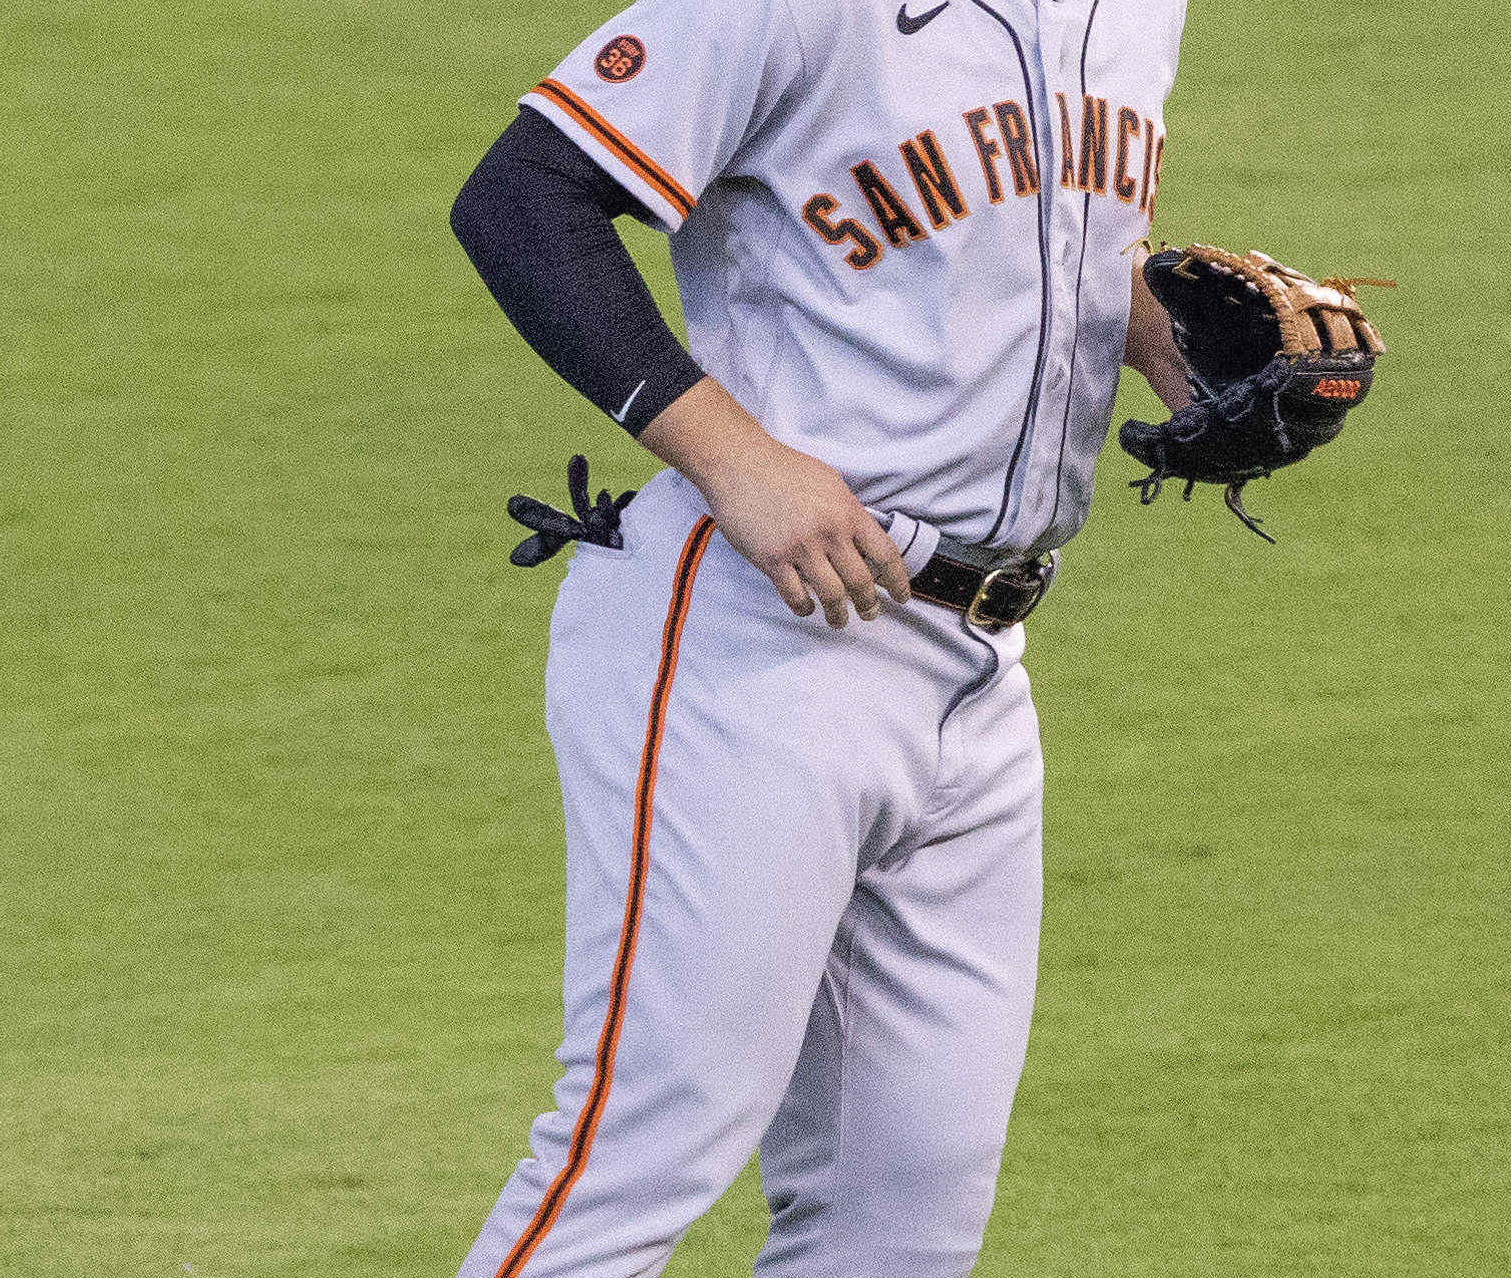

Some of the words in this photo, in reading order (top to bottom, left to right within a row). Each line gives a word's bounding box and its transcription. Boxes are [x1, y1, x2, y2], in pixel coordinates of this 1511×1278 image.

[600, 48, 633, 76] 36
[801, 128, 972, 271] SAN
[962, 91, 1165, 222] FRANCI
